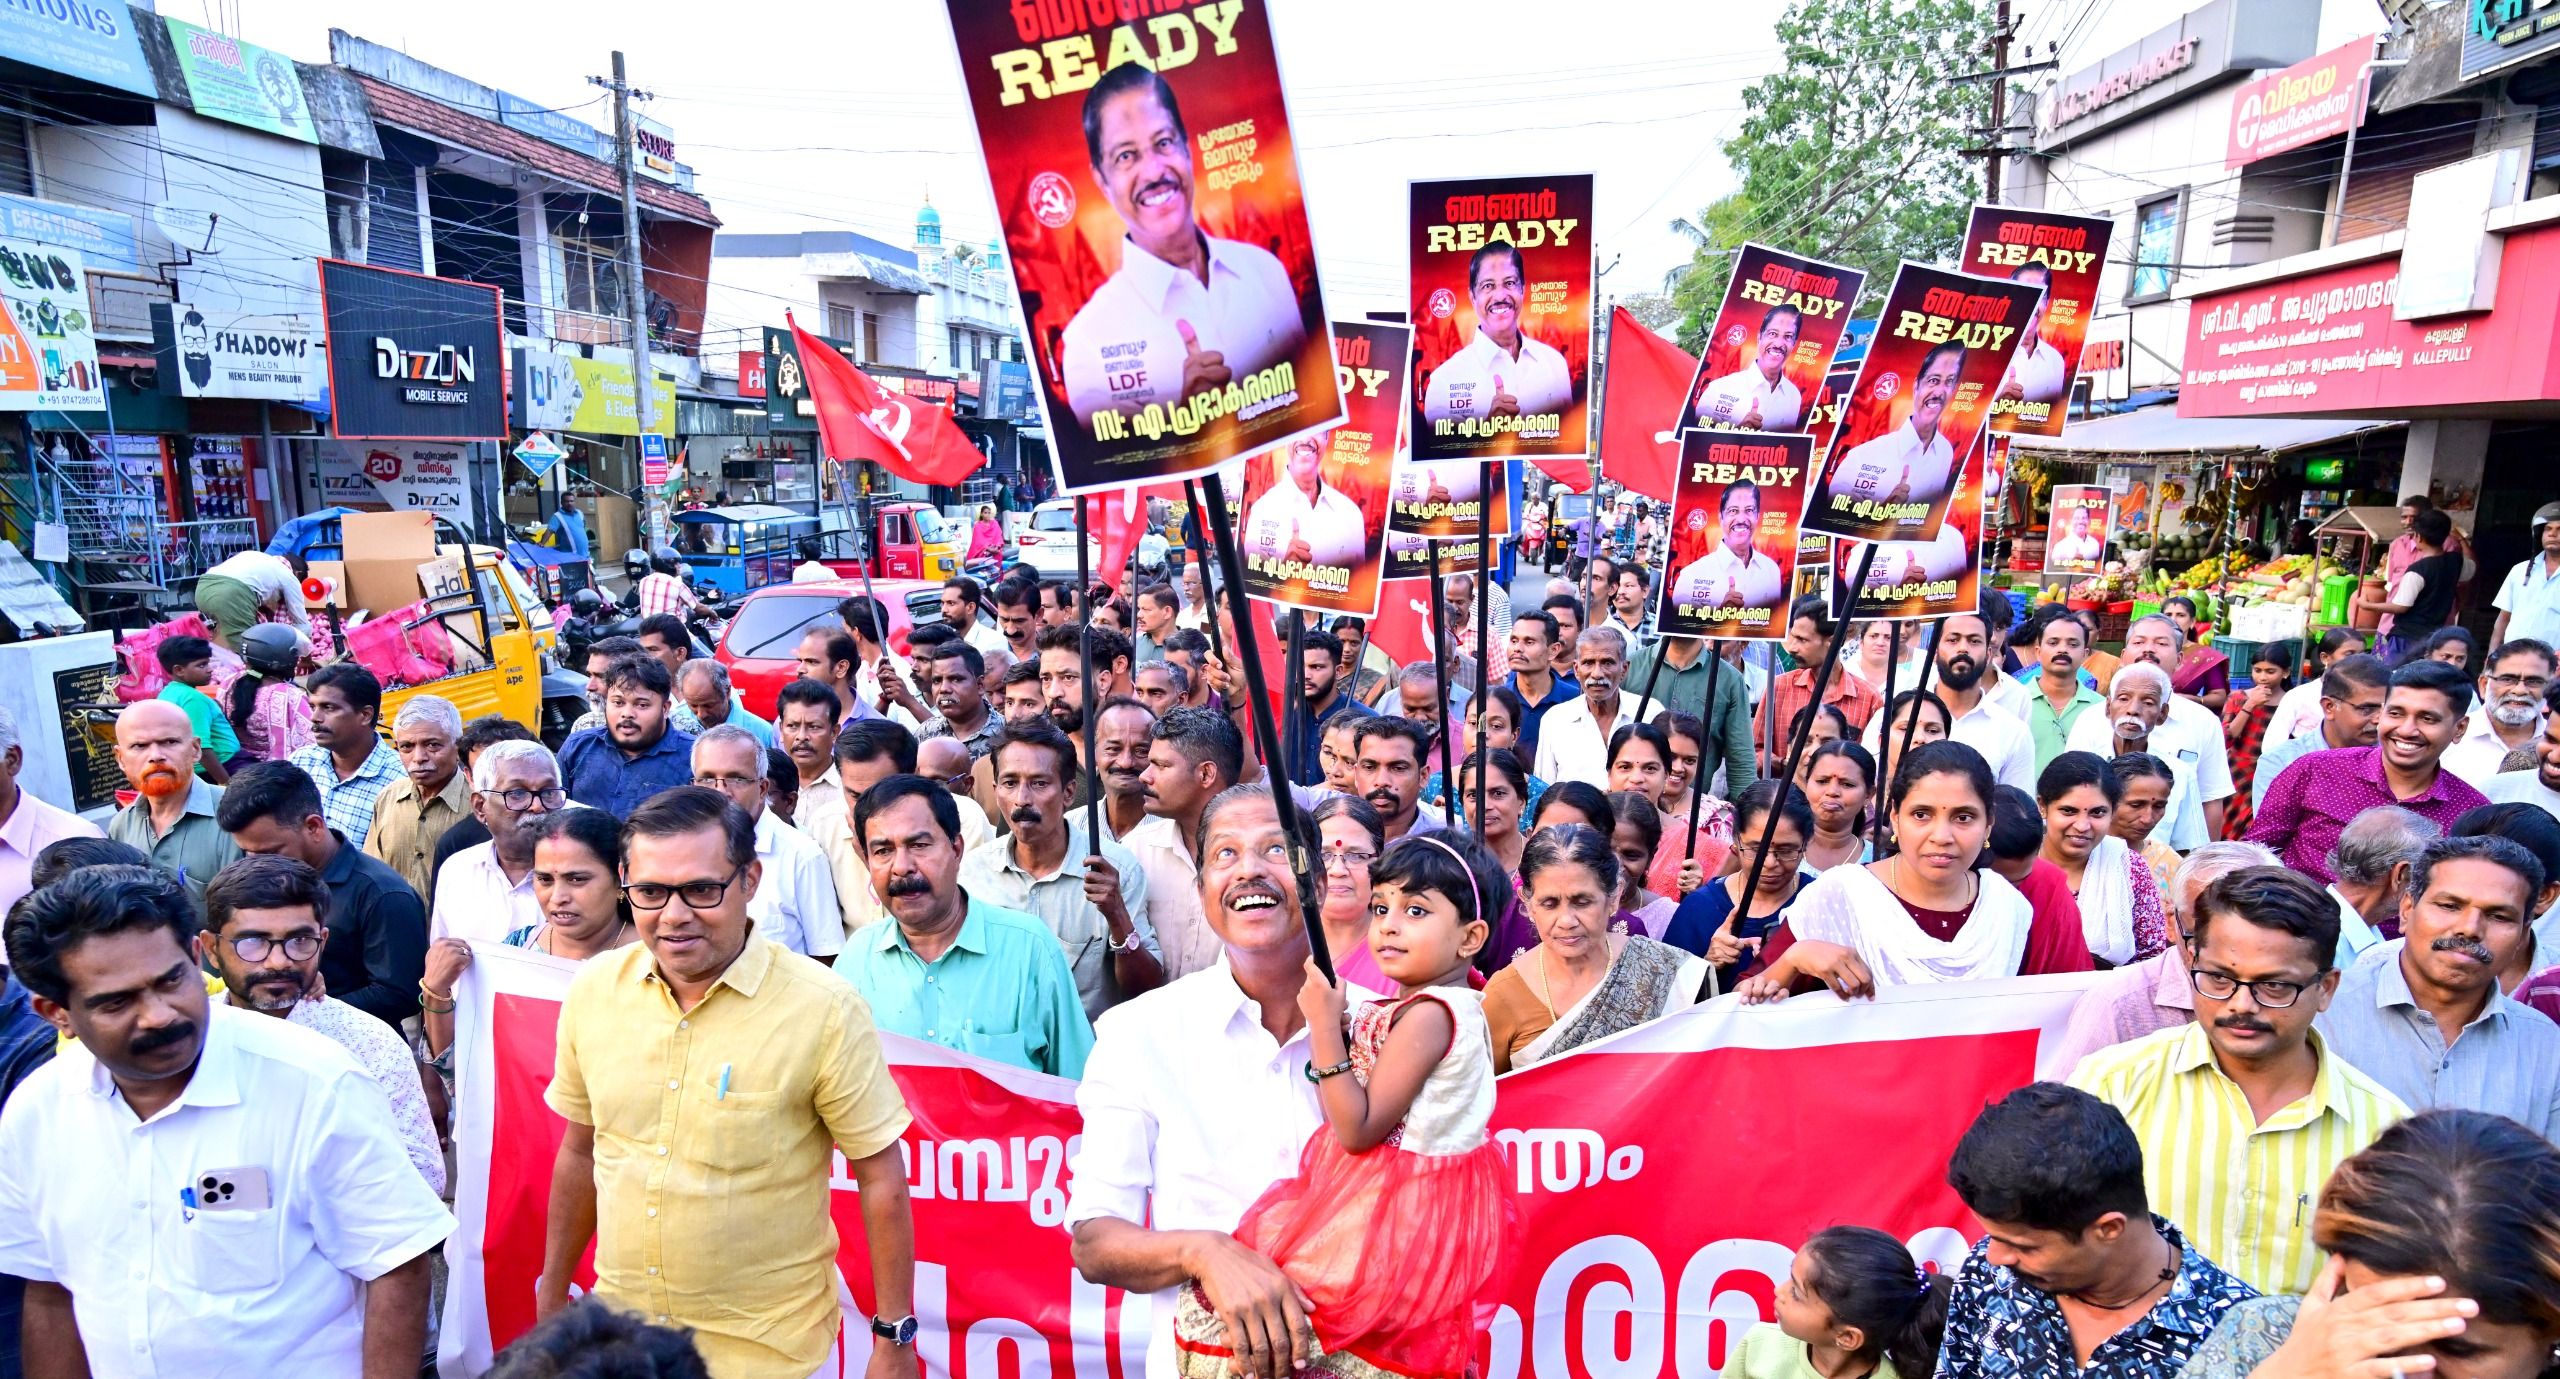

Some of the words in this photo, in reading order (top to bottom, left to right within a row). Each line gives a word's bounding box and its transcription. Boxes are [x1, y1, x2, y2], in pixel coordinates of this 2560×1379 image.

[991, 0, 1244, 107] READY
[2085, 71, 2129, 114] SUPER
[2129, 38, 2194, 92] MARKET
[2262, 64, 2337, 117] വിജയ
[638, 128, 676, 162] SCORE
[1207, 161, 1263, 191] തുടരും
[1445, 188, 1557, 224] ഞങ്ങൾ
[1427, 218, 1578, 253] READY
[1998, 220, 2087, 251] ഞങ്ങൾ
[1977, 241, 2097, 275] READY
[1761, 262, 1840, 298] ഞങ്ങൾ
[1740, 278, 1845, 321] READY
[1921, 286, 2013, 324] ഞങ്ങൾ
[1893, 310, 2016, 352] READY
[214, 331, 308, 359] SHADOWS
[251, 360, 280, 370] SALON
[2412, 346, 2473, 366] KALLEPULLY
[228, 371, 247, 382] MENS
[248, 372, 272, 383] BEAUTY
[274, 373, 303, 384] PARLOUR
[601, 377, 634, 398] Friends
[1108, 371, 1148, 392] LDF
[47, 395, 60, 405] +91
[405, 388, 436, 402] MOBILE
[437, 391, 469, 404] SERVICE
[1449, 399, 1473, 409] LDF
[606, 400, 613, 416] &
[1714, 404, 1733, 415] LDF
[1708, 443, 1789, 466] ഞങ്ങൾ
[371, 458, 396, 475] 20
[1691, 462, 1800, 487] READY
[1402, 486, 1416, 496] LDF
[1853, 478, 1878, 490] LDF
[2058, 498, 2108, 510] READY
[1260, 535, 1277, 547] LDF
[1692, 590, 1711, 599] LDF
[506, 674, 524, 685] ape
